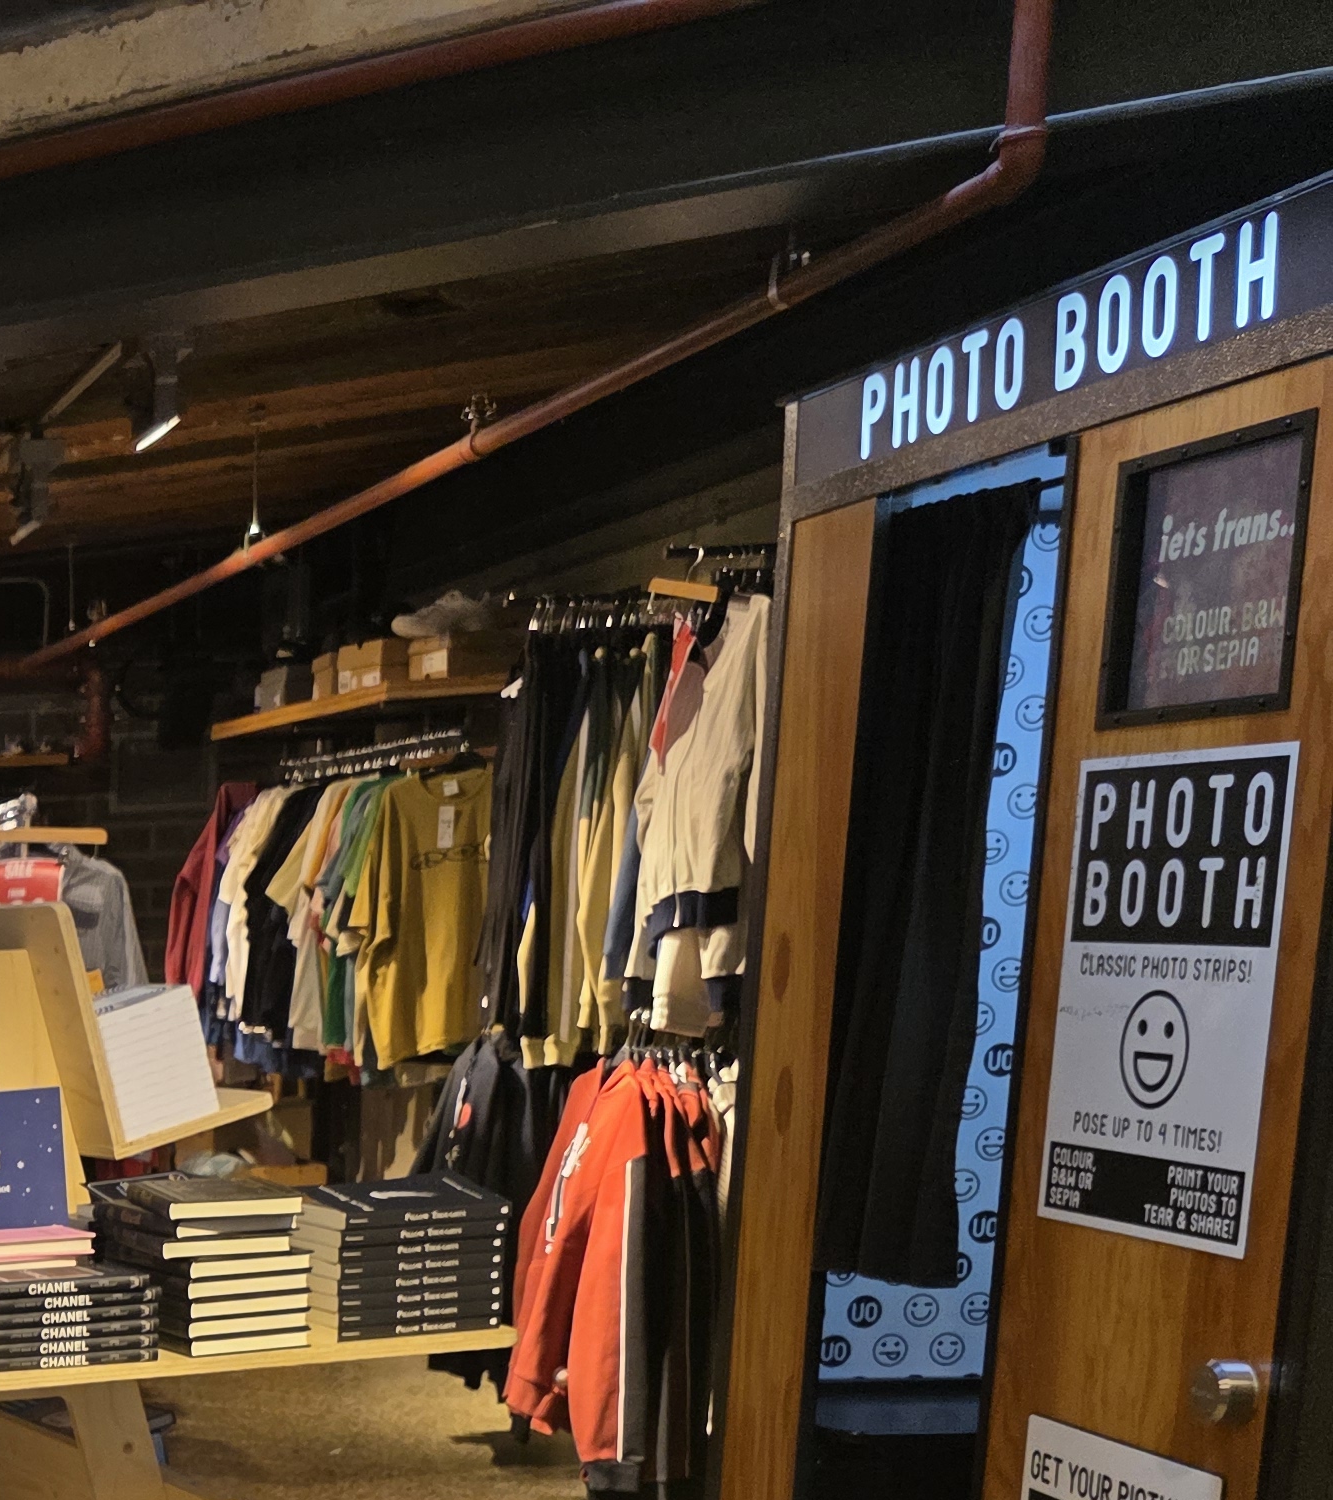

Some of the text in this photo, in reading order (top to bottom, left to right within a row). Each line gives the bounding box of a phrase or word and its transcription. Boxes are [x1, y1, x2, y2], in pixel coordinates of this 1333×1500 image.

[860, 211, 1278, 460] PHOTO BOOTH
[1177, 636, 1259, 676] OR SEPIA
[1089, 771, 1275, 851] PHOTO
[1082, 856, 1267, 929] BOOTH
[1080, 951, 1252, 983] CLASSIC PHOTO STRIPS!
[1073, 1111, 1223, 1154] POSE UP TO 4 TIMES!
[1053, 1146, 1097, 1173] COLOUR,
[1051, 1167, 1094, 1190] B&W OR
[1167, 1165, 1239, 1196] PRINT YOUR
[1049, 1186, 1080, 1209] SEPIA
[1169, 1187, 1237, 1218] PHOTOS TO
[1143, 1203, 1235, 1240] TEAR & SHARE!
[28, 1281, 78, 1296] CHANEL
[44, 1294, 93, 1309] CHANEL
[41, 1310, 91, 1326] CHANEL
[851, 1302, 878, 1323] UO
[40, 1326, 90, 1341] CHANEL
[39, 1341, 89, 1355] CHANEL
[820, 1342, 847, 1362] UO
[39, 1355, 90, 1370] CHANEL
[1030, 1450, 1063, 1489] GET
